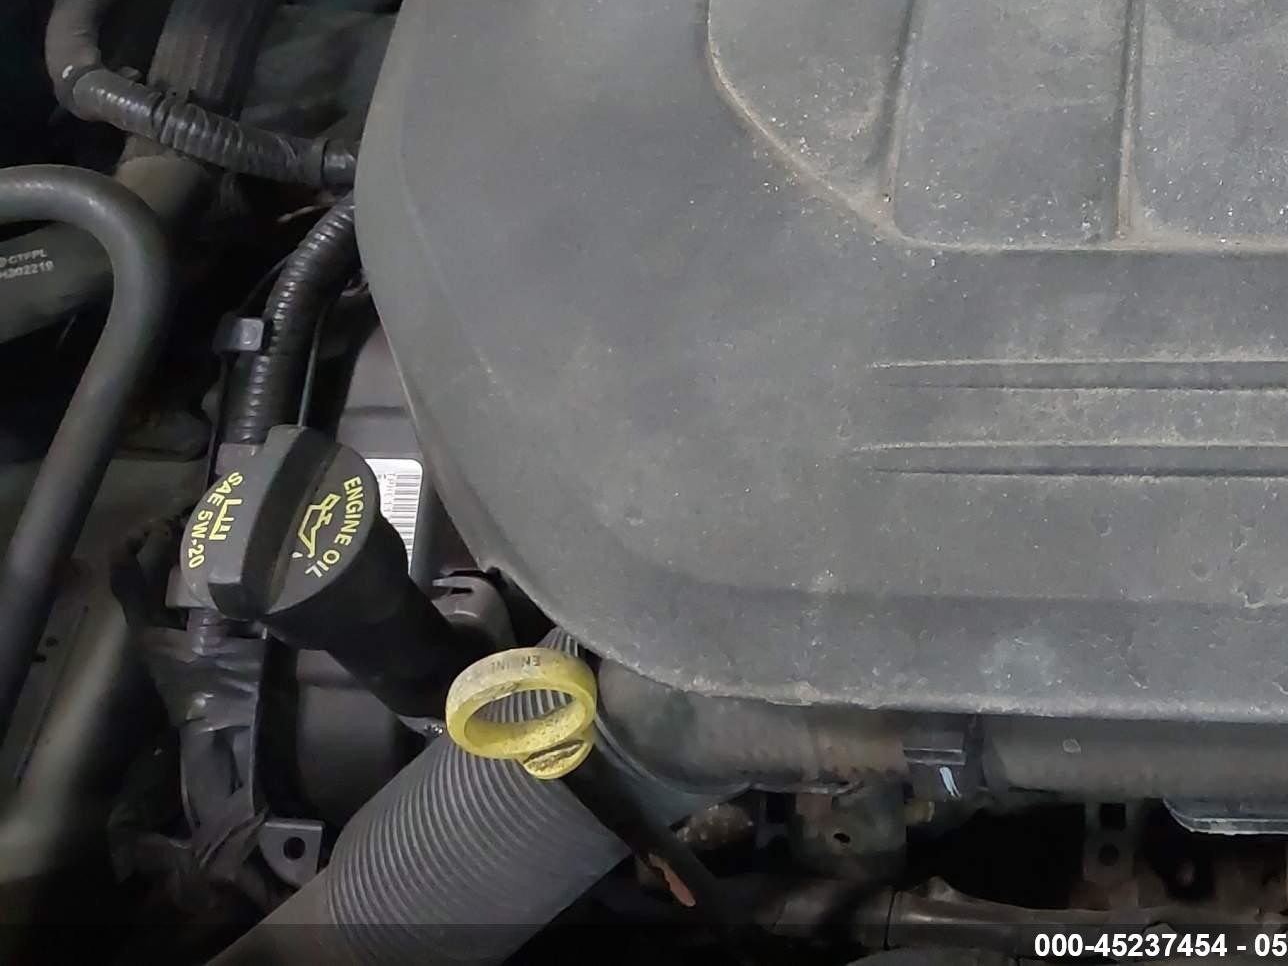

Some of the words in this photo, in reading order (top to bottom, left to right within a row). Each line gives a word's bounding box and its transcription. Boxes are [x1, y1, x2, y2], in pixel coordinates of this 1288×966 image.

[207, 472, 244, 506] SAE
[334, 476, 364, 546] ENGINE
[188, 510, 214, 569] 5W-20
[305, 549, 340, 578] OIL
